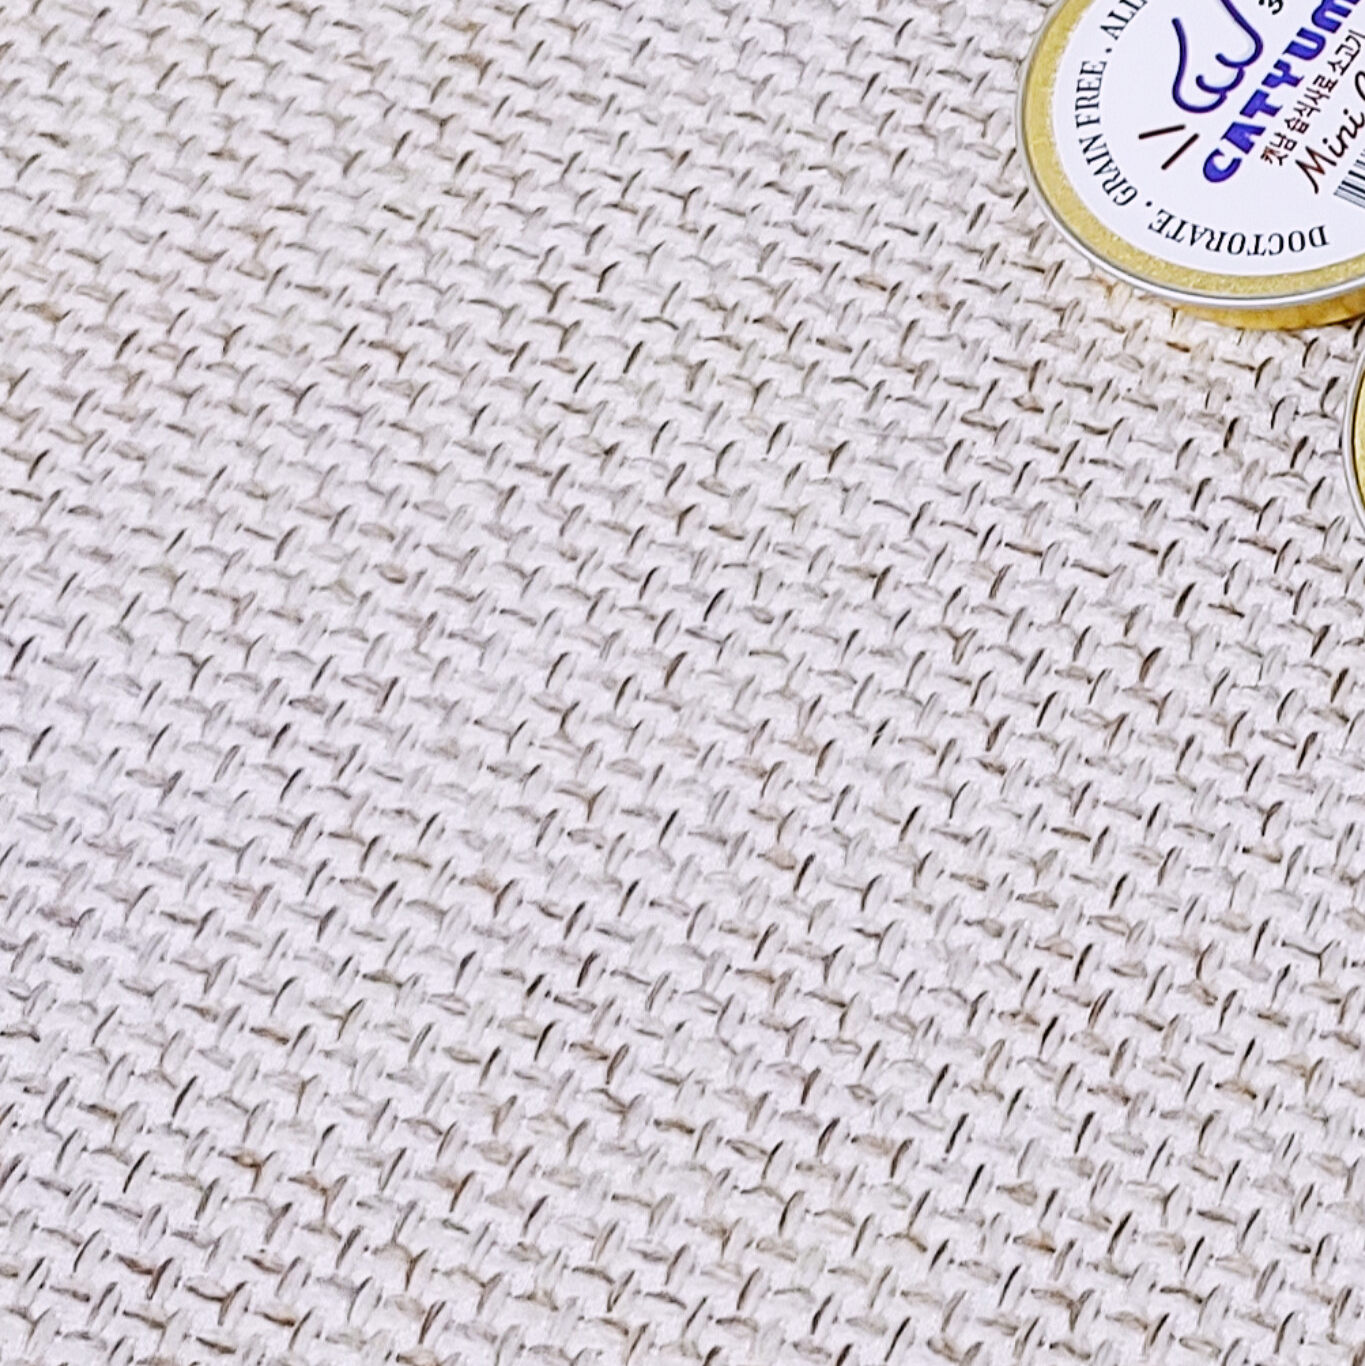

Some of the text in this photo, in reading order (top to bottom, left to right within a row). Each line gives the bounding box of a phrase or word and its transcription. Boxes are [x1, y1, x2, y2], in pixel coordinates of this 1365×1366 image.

[1099, 0, 1147, 41] ALL
[1284, 74, 1339, 133] 습식사료
[1075, 59, 1140, 209] GRAIN FREE
[1294, 108, 1365, 195] Mini
[1147, 207, 1330, 257] DOCTORATE
